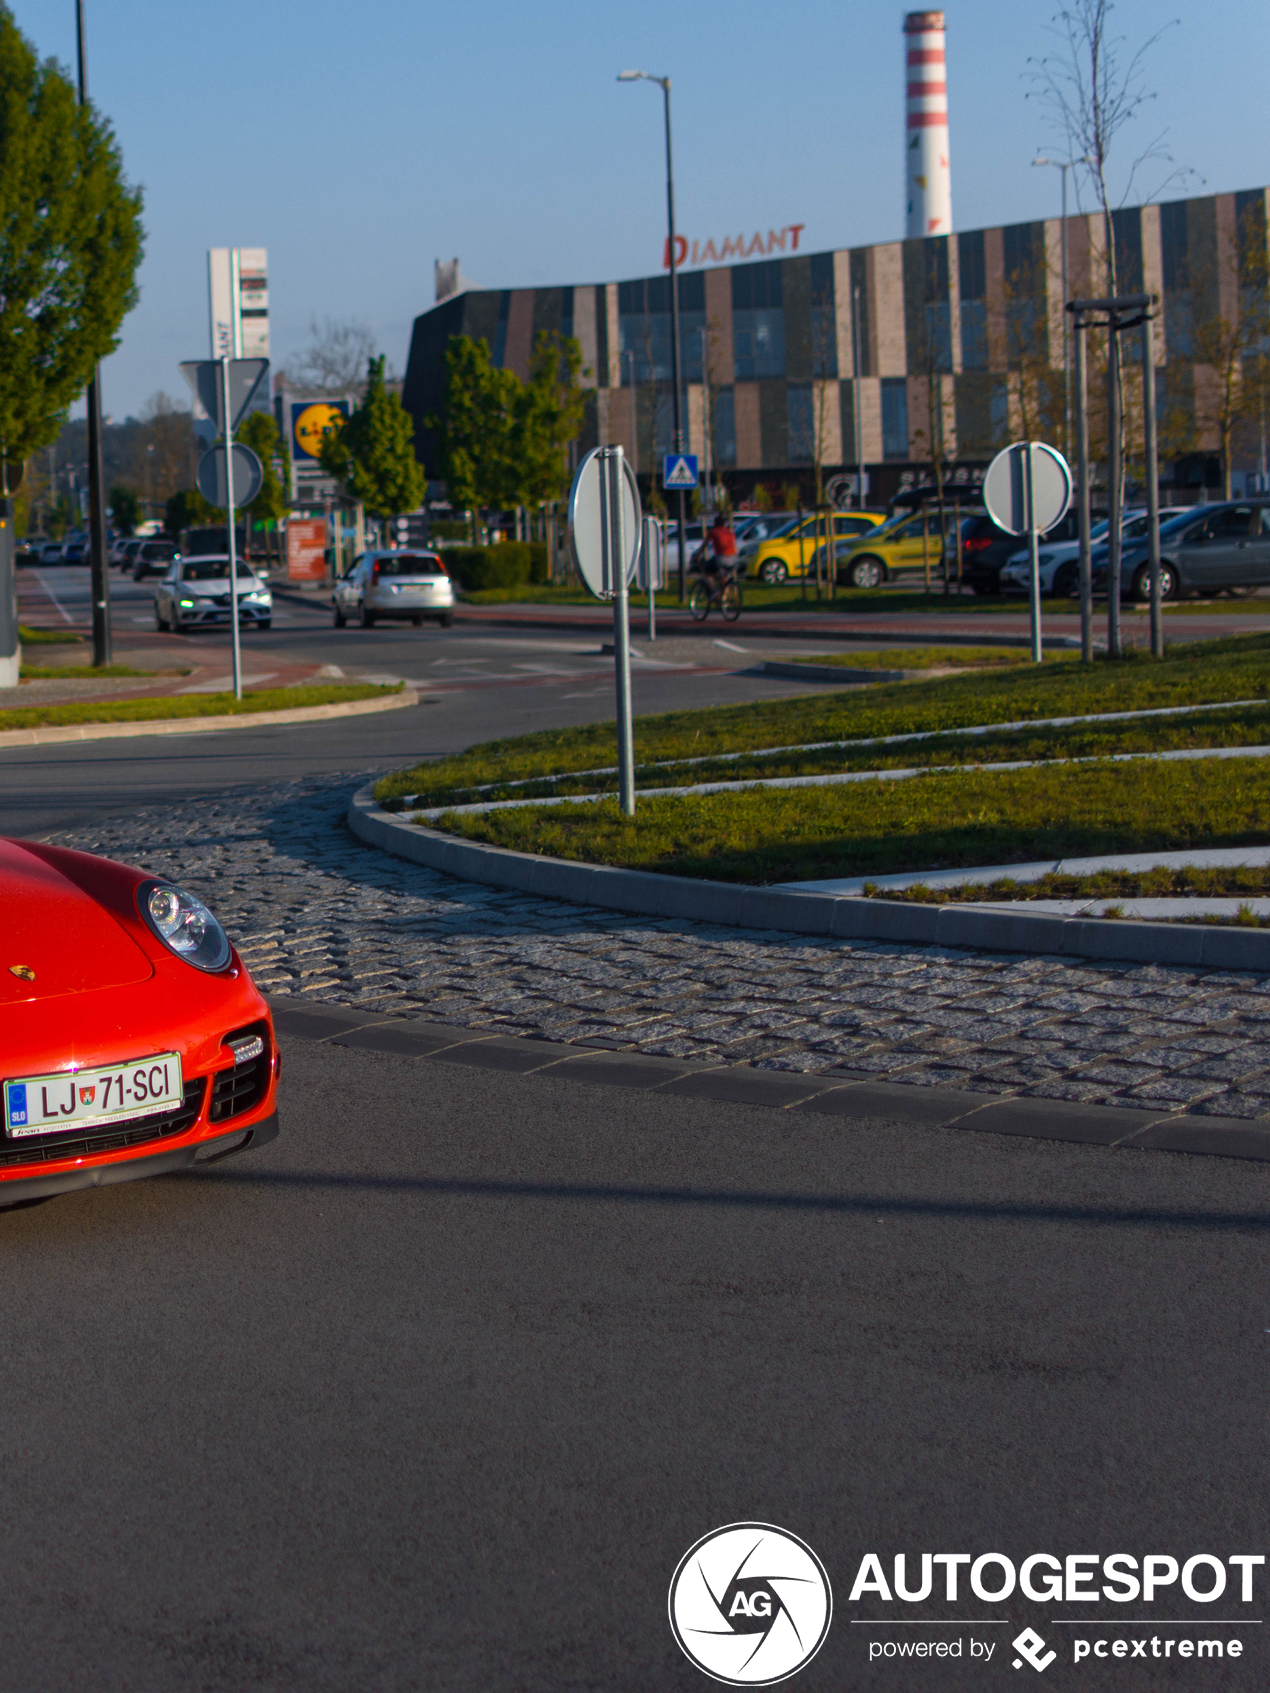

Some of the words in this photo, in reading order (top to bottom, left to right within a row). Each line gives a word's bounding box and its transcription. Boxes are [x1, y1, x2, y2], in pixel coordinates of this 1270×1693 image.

[662, 223, 805, 269] DIAMANT
[41, 1083, 76, 1118] LJ
[99, 1064, 170, 1109] 71-SCI
[11, 1111, 26, 1122] SLO
